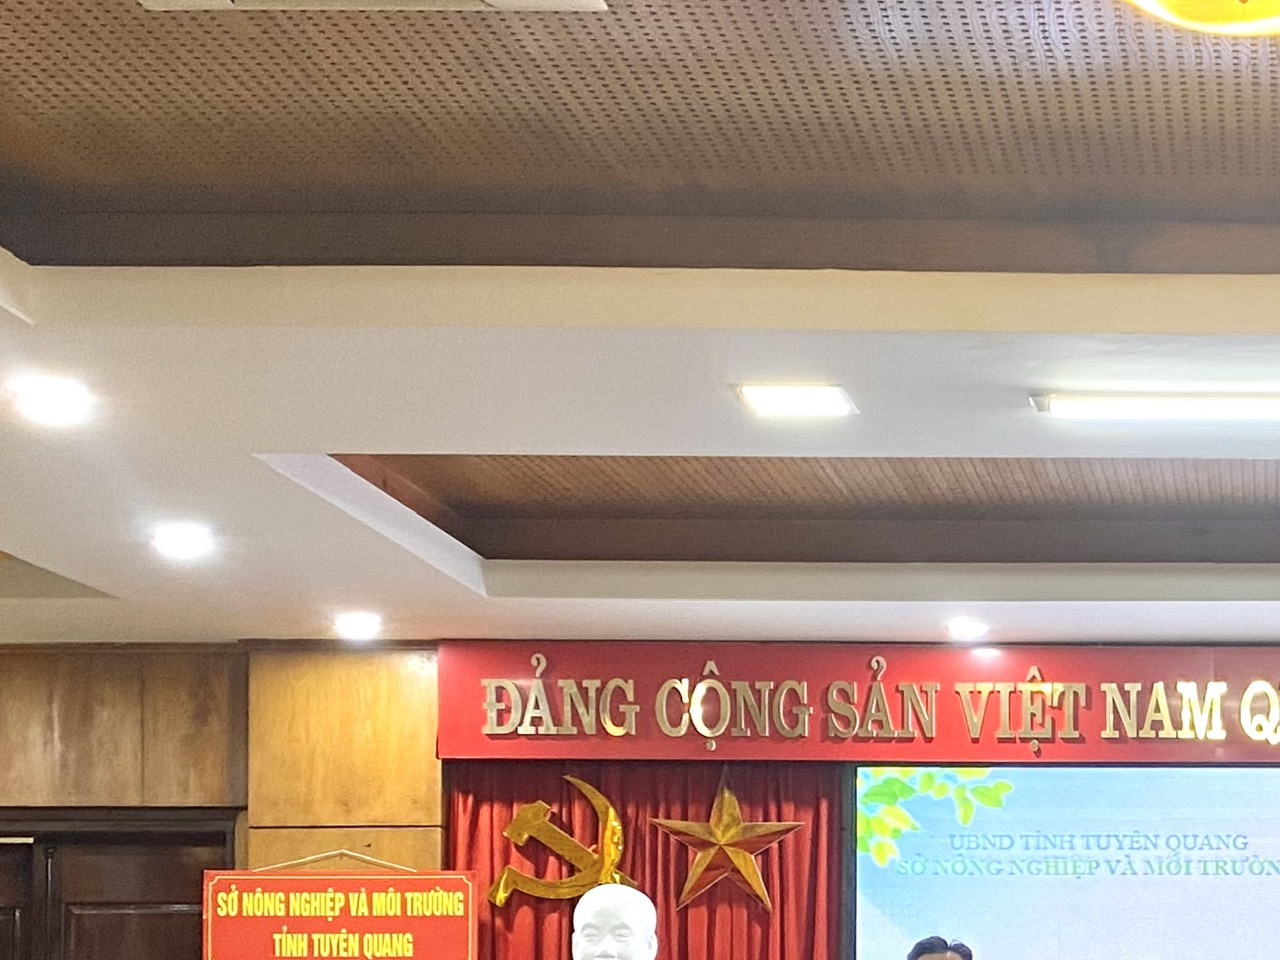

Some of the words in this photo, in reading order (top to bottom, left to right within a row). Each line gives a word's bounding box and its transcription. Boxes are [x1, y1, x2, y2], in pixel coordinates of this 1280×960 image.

[481, 654, 640, 738] ĐẢNG
[656, 660, 813, 751] CỘNG
[828, 655, 941, 740] SẢN
[956, 665, 1086, 757] VIỆT
[1100, 681, 1228, 740] NAM
[948, 834, 1015, 851] UBND
[1020, 830, 1076, 851] TỈNH
[1081, 830, 1159, 851] TUYÊN
[1165, 834, 1249, 855] QUANG
[896, 853, 928, 876] SỞ
[932, 853, 1005, 876] NÔNG
[1008, 855, 1101, 880] NGHIỆP
[1104, 854, 1138, 876] VÀ
[1143, 854, 1193, 876] MÔI
[216, 884, 239, 917] SỞ
[241, 887, 286, 917] NÔNG
[289, 887, 346, 922] NGHIỆP
[349, 887, 369, 917] VÀ
[372, 887, 402, 917] MÔI
[405, 886, 465, 917] TRƯỜNG
[273, 925, 308, 958] TỈNH
[311, 928, 360, 958] TUYÊN
[363, 932, 414, 960] QUANG
